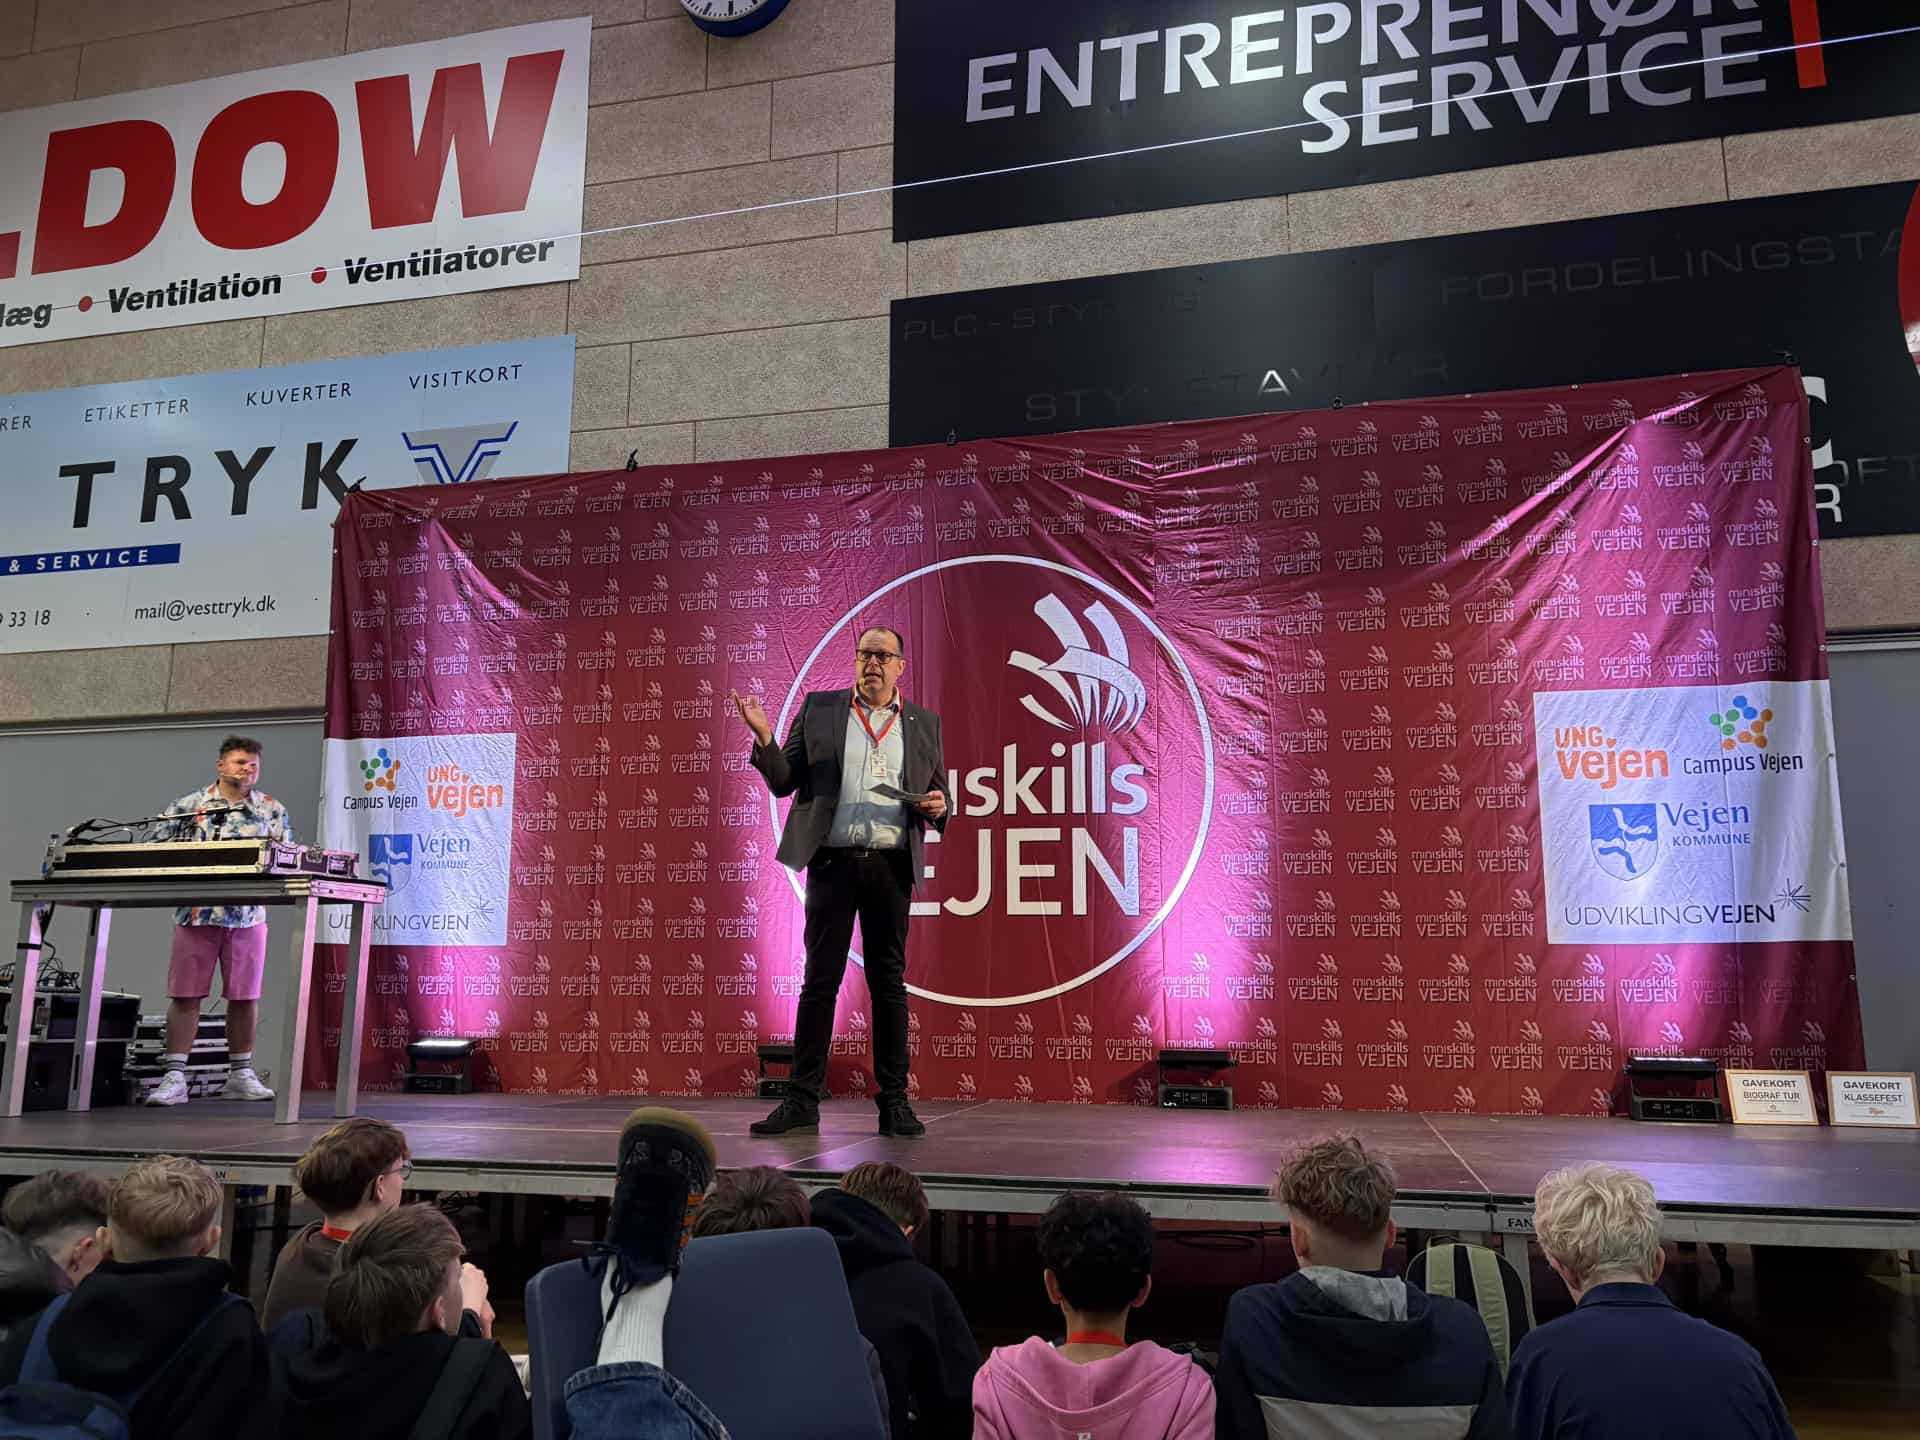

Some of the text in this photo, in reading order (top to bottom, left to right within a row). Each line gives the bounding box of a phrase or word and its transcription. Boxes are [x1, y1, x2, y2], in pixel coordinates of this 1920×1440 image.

[1301, 19, 1767, 154] SERVICE
[0, 49, 566, 279] DOW
[108, 272, 282, 314] Ventilation
[344, 238, 555, 286] Ventilatorer
[0, 364, 523, 431] RER ETIKETTER KUVERTER VISITKORT
[1715, 406, 1768, 422] VEJEN
[1653, 461, 1705, 474] miniskills
[58, 438, 359, 528] TRYK
[1458, 476, 1507, 490] miniskills
[1654, 472, 1705, 487] VEJEN
[1333, 488, 1381, 502] miniskills
[1395, 483, 1443, 496] miniskills
[1458, 487, 1507, 503] VEJEN
[1272, 494, 1319, 507] miniskills
[1334, 499, 1380, 514] VEJEN
[1396, 493, 1443, 508] VEJEN
[1273, 504, 1318, 519] VEJEN
[936, 528, 976, 541] VEJEN
[1726, 530, 1778, 546] VEJEN
[1658, 534, 1710, 550] VEJEN
[631, 548, 668, 561] VEJEN
[680, 546, 718, 558] VEJEN
[1335, 545, 1383, 558] miniskills
[8, 550, 149, 573] & SERVICE
[533, 555, 570, 566] VEJEN
[1336, 555, 1383, 570] VEJEN
[629, 592, 668, 602] miniskills
[679, 589, 718, 600] miniskills
[1595, 590, 1647, 603] miniskills
[134, 596, 276, 622] mail@vesttryk.dk
[630, 601, 667, 614] VEJEN
[680, 599, 717, 611] VEJEN
[1400, 602, 1450, 615] miniskills
[1596, 602, 1646, 616] VEJEN
[8, 610, 50, 627] 33 18
[1337, 606, 1386, 619] miniskills
[1338, 617, 1385, 632] VEJEN
[1401, 613, 1449, 628] VEJEN
[676, 643, 716, 653] miniskills
[677, 652, 715, 665] VEJEN
[434, 664, 469, 676] VEJEN
[528, 660, 565, 671] VEJEN
[1340, 665, 1389, 678] miniskills
[1404, 662, 1453, 674] miniskills
[1340, 676, 1388, 690] VEJEN
[1404, 673, 1453, 687] VEJEN
[673, 697, 713, 707] miniskills
[674, 707, 712, 719] VEJEN
[1342, 725, 1392, 737] miniskills
[1406, 723, 1457, 735] miniskills
[1343, 737, 1391, 750] VEJEN
[1407, 734, 1456, 748] VEJEN
[1555, 726, 1603, 748] UNG
[671, 750, 711, 761] miniskills
[672, 760, 710, 772] VEJEN
[1684, 752, 1803, 775] Campus Vejen
[428, 764, 460, 783] UNG
[1345, 786, 1395, 798] miniskills
[1410, 784, 1460, 796] miniskills
[344, 794, 418, 811] Campus Vejen
[1346, 798, 1394, 811] VEJEN
[1411, 796, 1460, 810] VEJEN
[669, 805, 709, 815] miniskills
[670, 815, 708, 827] VEJEN
[1662, 802, 1749, 832] Vejen
[417, 832, 470, 858] Vejen
[1672, 832, 1751, 847] KOMMUNE
[1283, 849, 1332, 860] miniskills
[1347, 848, 1397, 860] miniskills
[1412, 847, 1463, 859] miniskills
[421, 860, 470, 870] KOMMUNE
[1284, 861, 1332, 874] VEJEN
[1348, 860, 1396, 873] VEJEN
[1413, 859, 1462, 873] VEJEN
[665, 916, 706, 926] miniskills
[1286, 912, 1336, 922] miniskills
[1351, 912, 1401, 922] miniskills
[1416, 911, 1467, 922] miniskills
[1482, 910, 1534, 922] miniskills
[1565, 904, 1776, 926] UDVIKLINGVEJEN
[666, 926, 704, 938] VEJEN
[1287, 924, 1335, 936] VEJEN
[1351, 924, 1400, 936] VEJEN
[1417, 923, 1466, 936] VEJEN
[1483, 923, 1533, 936] VEJEN
[663, 972, 704, 982] miniskills
[715, 972, 757, 982] miniskills
[1288, 975, 1338, 986] miniskills
[1353, 975, 1403, 986] miniskills
[1418, 976, 1470, 987] miniskills
[1485, 976, 1537, 987] miniskills
[1552, 976, 1605, 987] miniskills
[663, 983, 703, 995] VEJEN
[716, 983, 756, 995] VEJEN
[1289, 986, 1337, 1000] VEJEN
[1354, 987, 1403, 1000] VEJEN
[1419, 988, 1469, 1001] VEJEN
[1486, 988, 1536, 1001] VEJEN
[1553, 988, 1604, 1001] VEJEN
[1622, 988, 1678, 1002] VEJEN
[662, 1030, 704, 1040] miniskills
[1106, 1036, 1152, 1047] miniskills
[662, 1041, 703, 1052] VEJEN
[1293, 1040, 1342, 1051] miniskills
[1357, 1041, 1408, 1053] miniskills
[1423, 1042, 1475, 1054] miniskills
[1490, 1043, 1543, 1054] miniskills
[1557, 1043, 1612, 1055] miniskills
[1106, 1047, 1152, 1061] VEJEN
[1294, 1052, 1342, 1066] VEJEN
[1358, 1053, 1407, 1067] VEJEN
[1424, 1054, 1474, 1068] VEJEN
[1491, 1055, 1542, 1069] VEJEN
[1558, 1056, 1612, 1070] VEJEN
[1742, 1079, 1797, 1088] GAVEKORT
[1844, 1081, 1902, 1090] GAVEKORT
[1744, 1091, 1800, 1100] BIOGRAF TUR
[1844, 1093, 1903, 1103] KLASSEFEST
